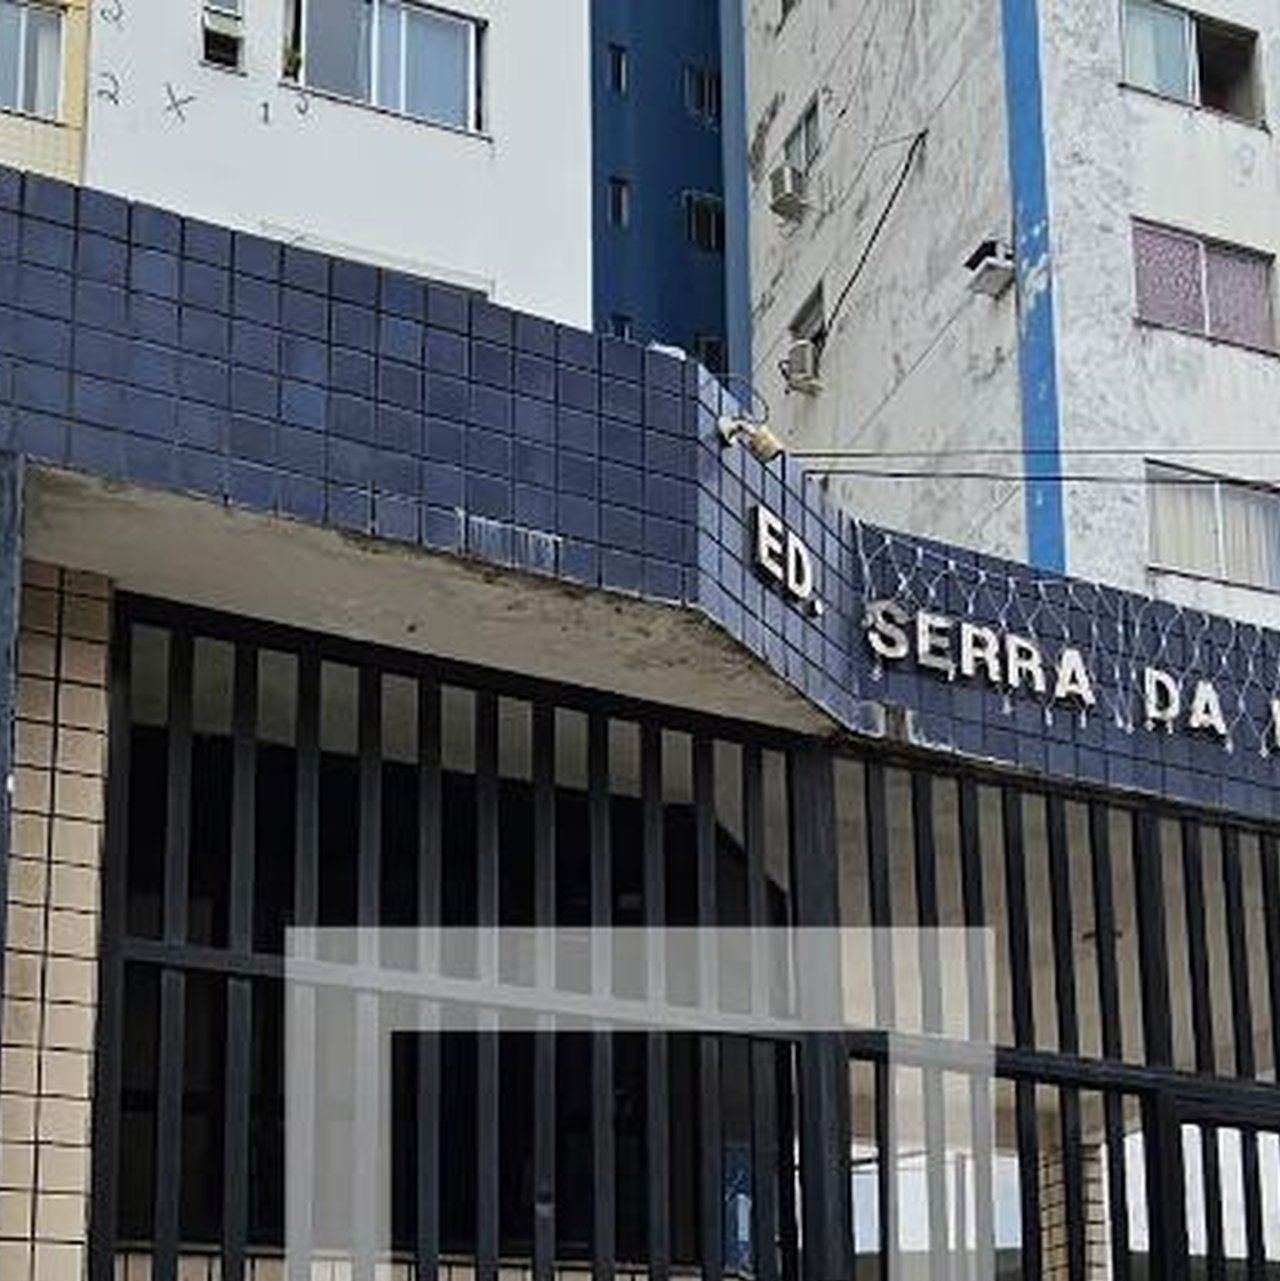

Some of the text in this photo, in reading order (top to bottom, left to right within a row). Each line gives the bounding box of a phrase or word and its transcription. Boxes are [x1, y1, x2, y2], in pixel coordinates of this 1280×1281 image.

[756, 505, 823, 616] ED.
[867, 600, 1096, 706] SERRA
[1144, 667, 1228, 736] DA
